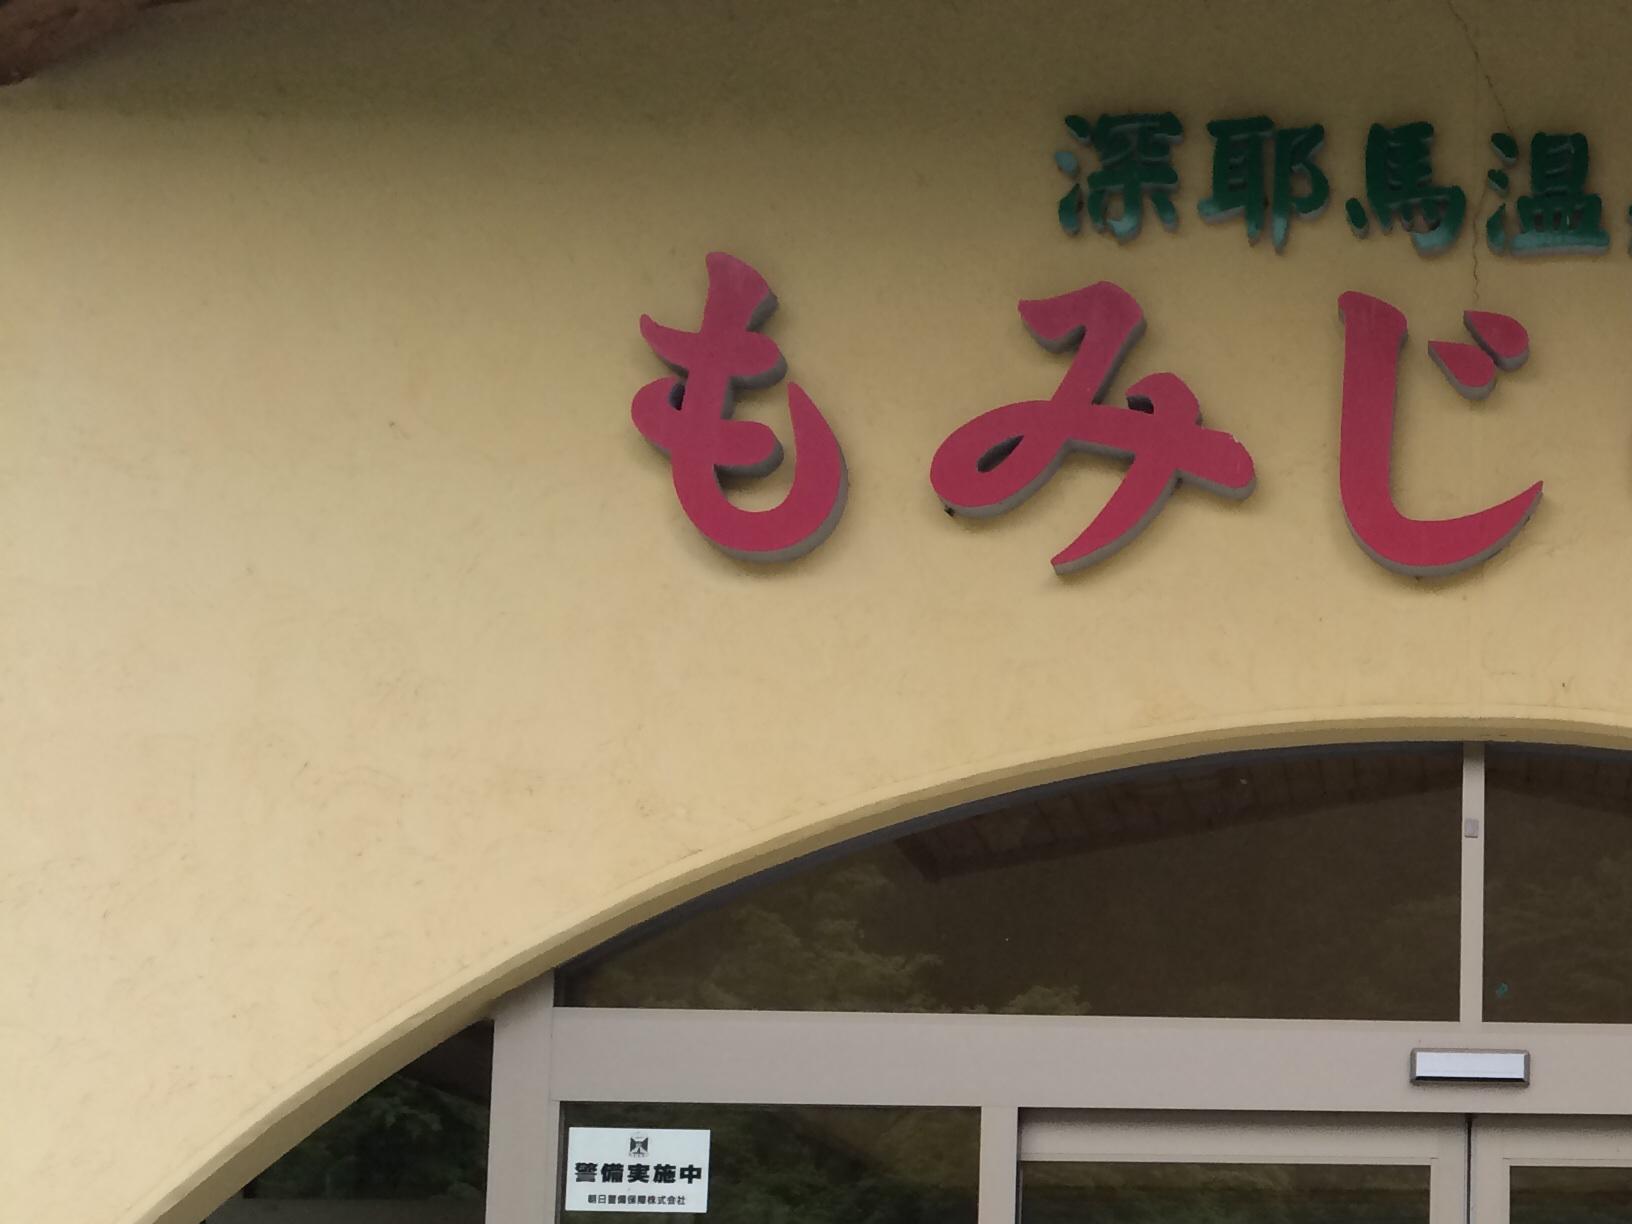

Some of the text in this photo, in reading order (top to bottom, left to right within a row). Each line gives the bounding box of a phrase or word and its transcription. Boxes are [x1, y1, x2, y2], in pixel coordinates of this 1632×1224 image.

[575, 1162, 702, 1184] 警備実施中
